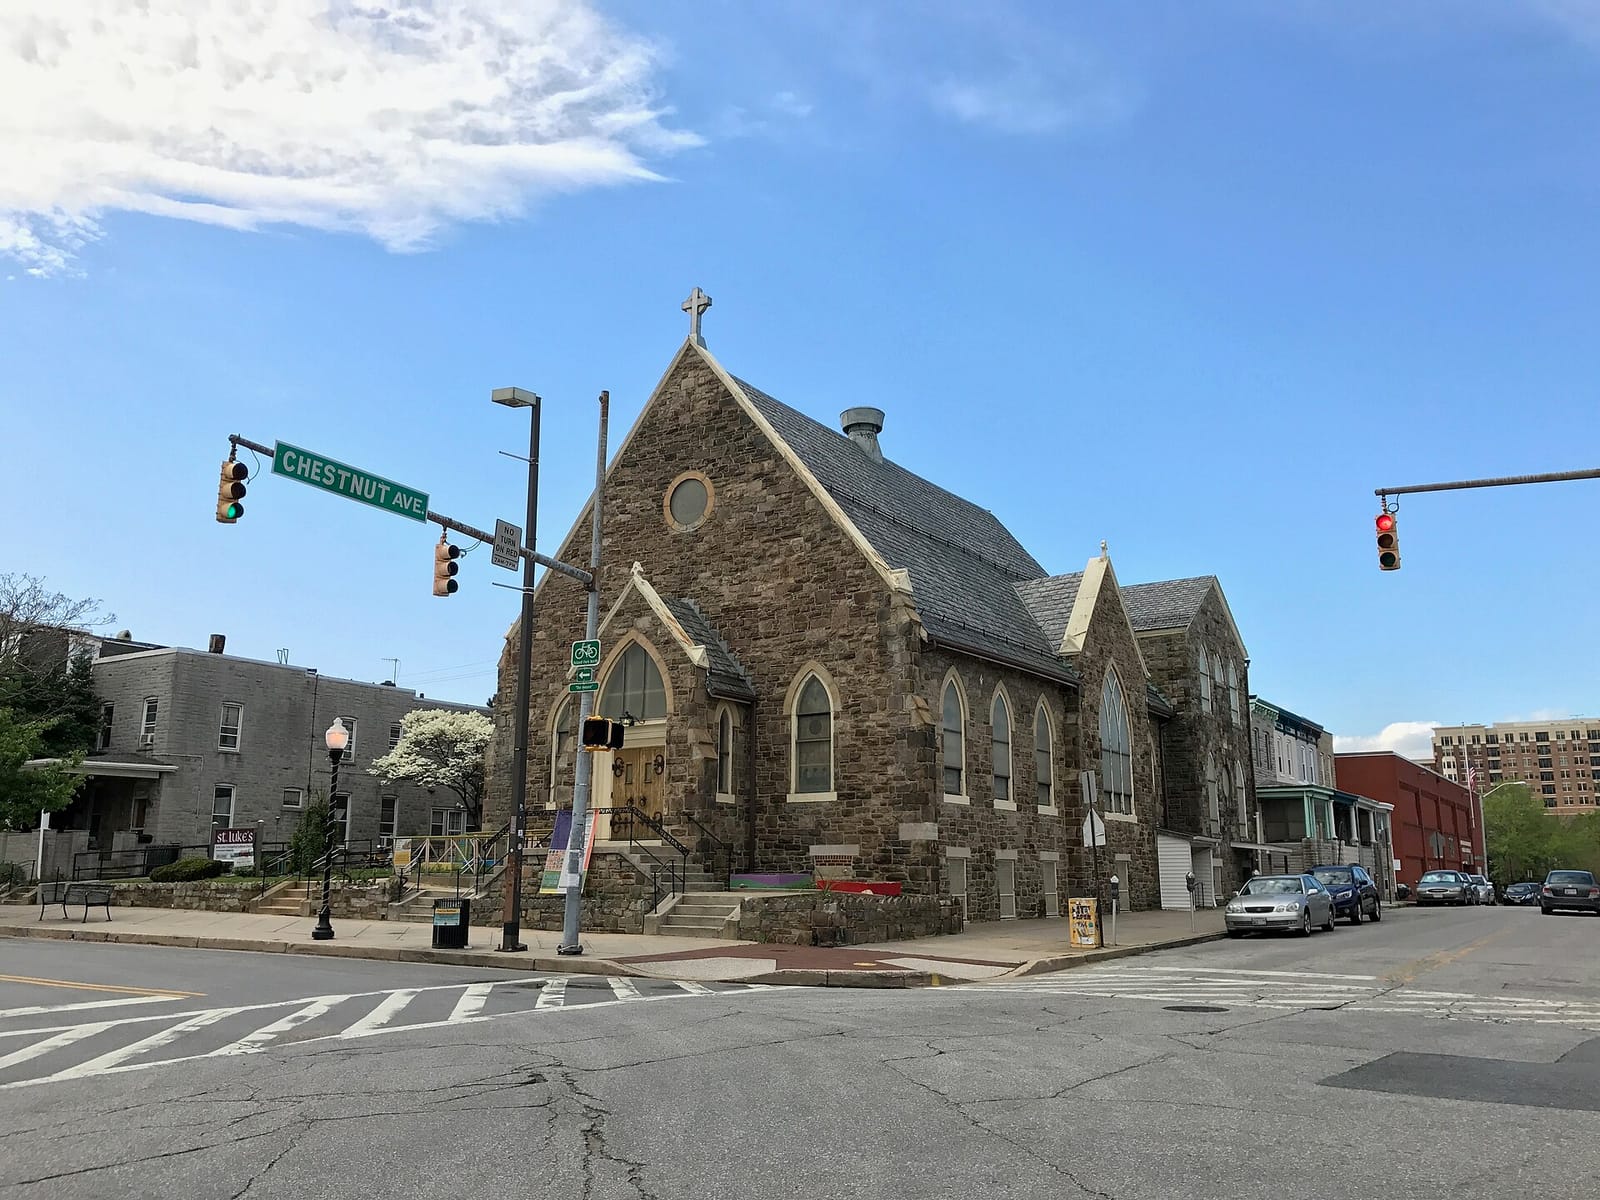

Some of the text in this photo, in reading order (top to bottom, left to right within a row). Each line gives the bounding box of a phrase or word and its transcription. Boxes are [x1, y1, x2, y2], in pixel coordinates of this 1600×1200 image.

[283, 450, 425, 515] CHESTNUT AVE.
[504, 526, 515, 536] NO
[501, 536, 516, 547] TURN
[495, 544, 518, 557] ON RED
[228, 830, 253, 843] luke's
